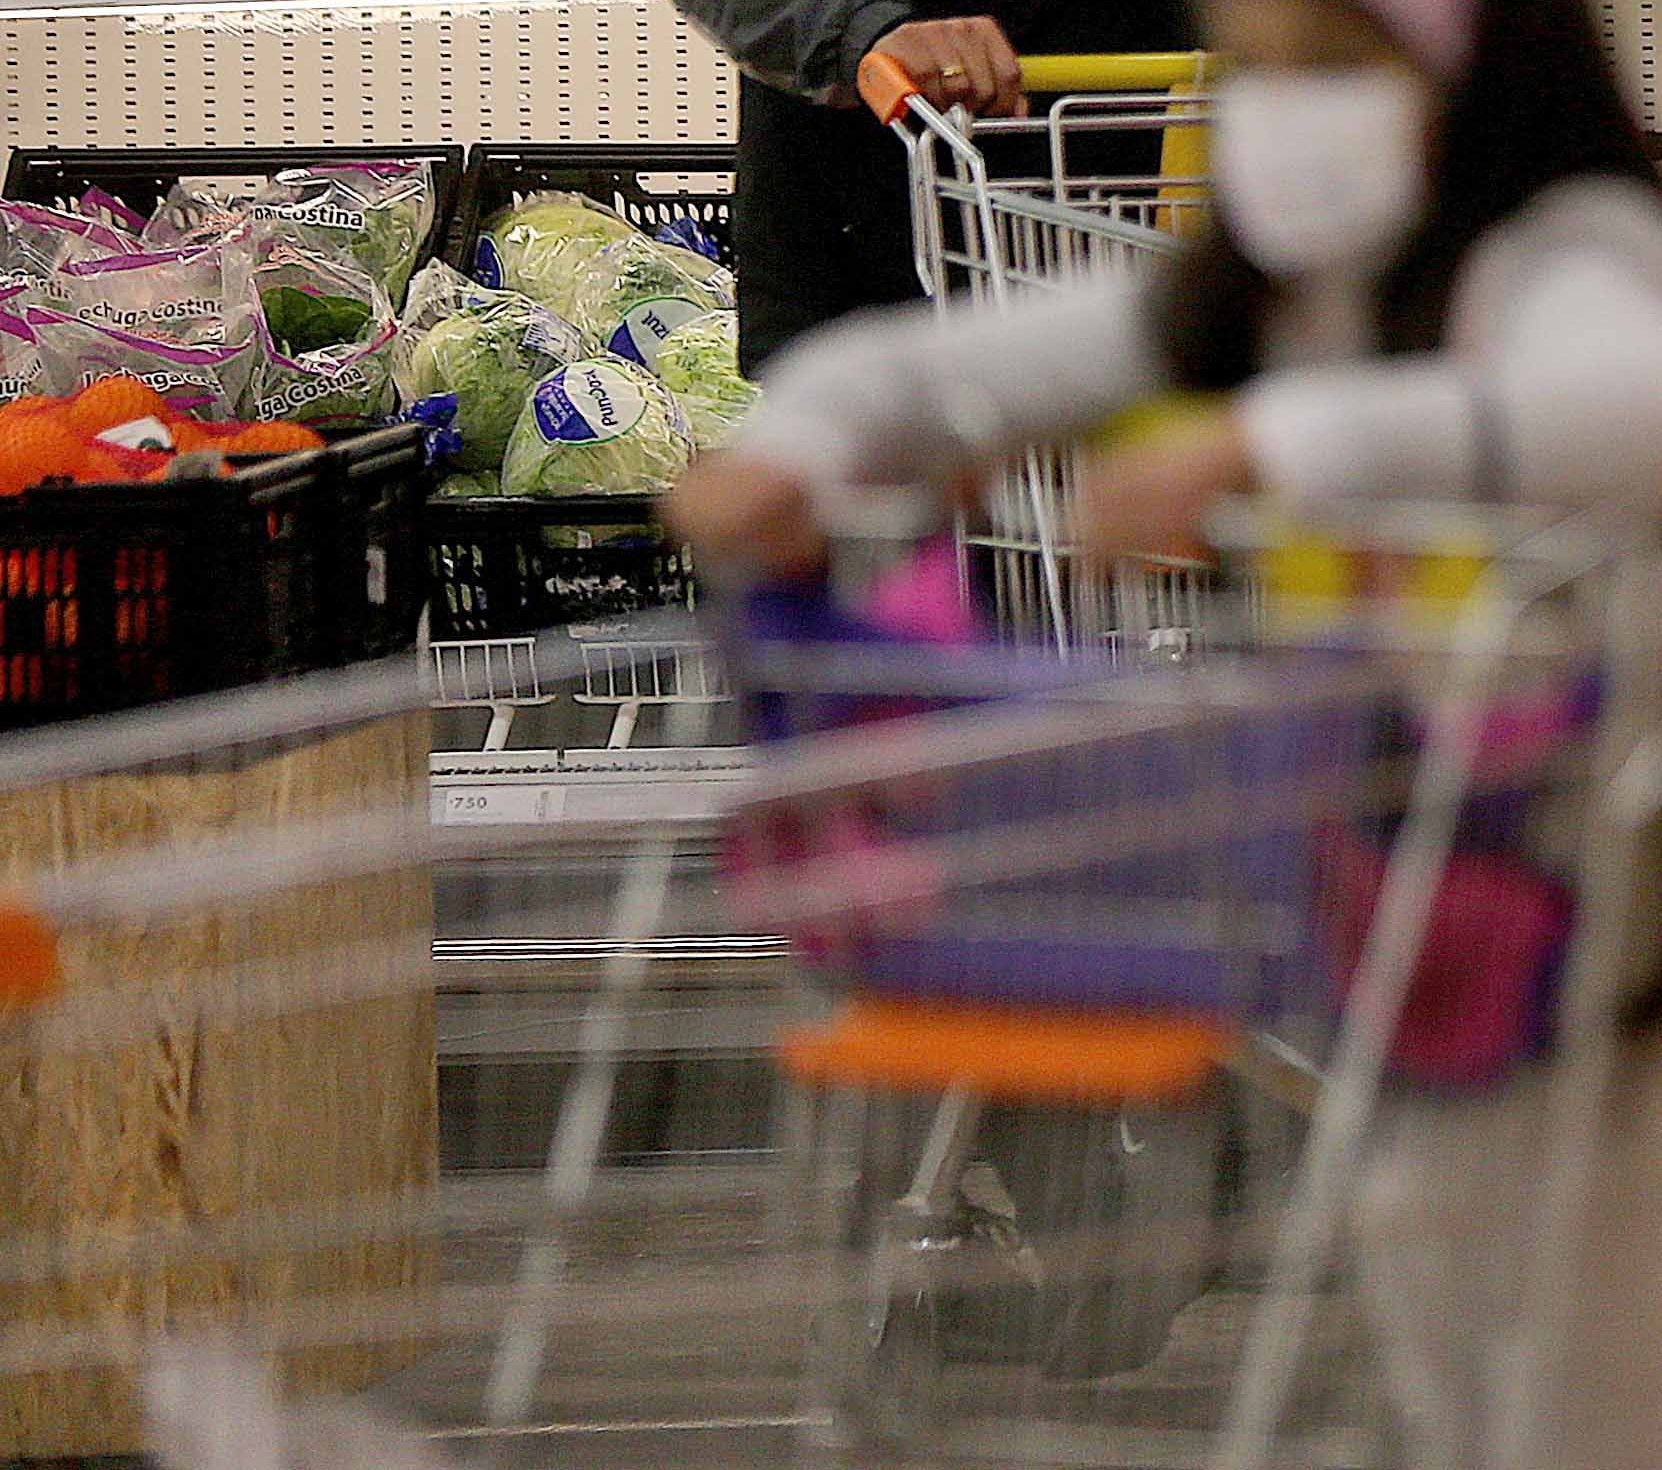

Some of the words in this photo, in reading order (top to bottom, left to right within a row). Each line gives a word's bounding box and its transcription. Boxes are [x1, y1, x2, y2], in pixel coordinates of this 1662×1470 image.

[280, 204, 365, 230] Costina
[80, 300, 145, 326] echuga
[287, 366, 363, 408] Costina
